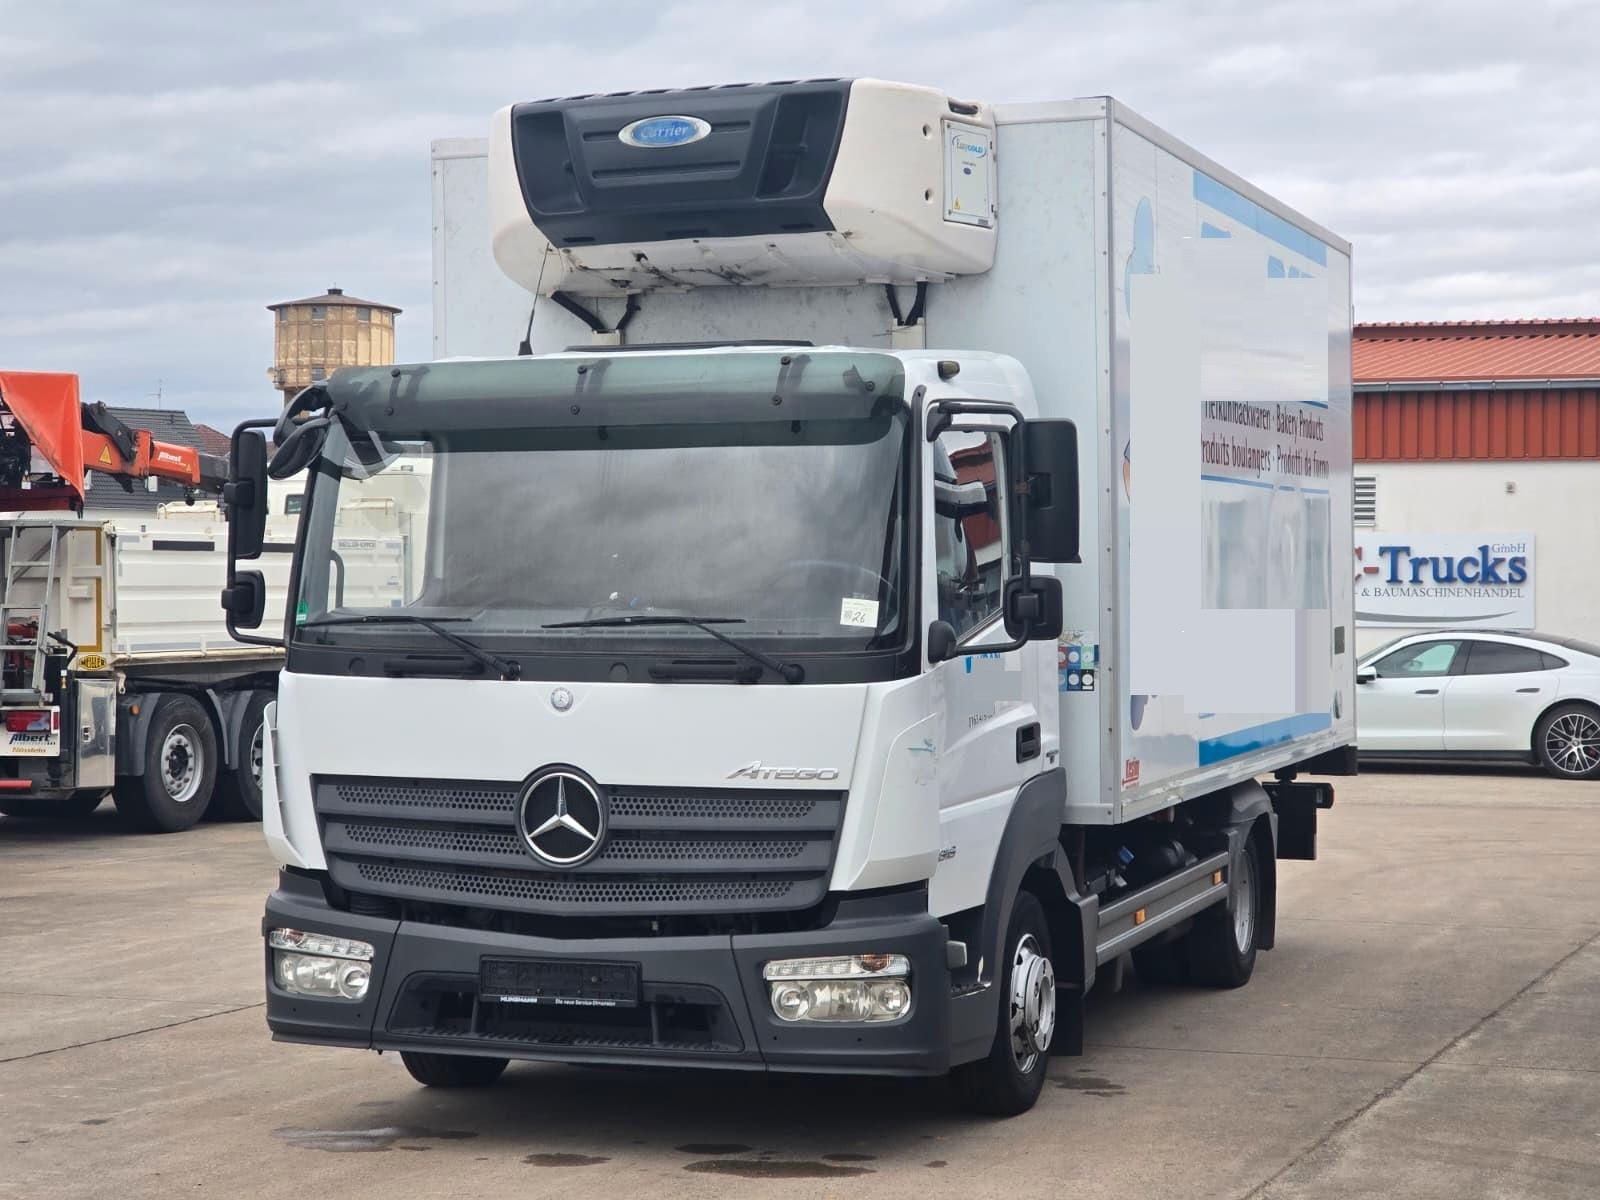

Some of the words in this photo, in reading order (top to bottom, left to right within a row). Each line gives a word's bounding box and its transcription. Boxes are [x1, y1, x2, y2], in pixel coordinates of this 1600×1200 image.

[641, 124, 689, 138] Carrier
[1276, 403, 1298, 444] Bakery
[1300, 407, 1324, 441] Products
[1232, 434, 1271, 479] boulangers
[1276, 444, 1303, 476] Prodotti
[1304, 450, 1312, 477] da
[1491, 544, 1526, 553] GmbH
[1361, 588, 1370, 597] &
[1374, 587, 1525, 598] BAUMASCHINENHANDEL
[9, 733, 52, 745] Albert
